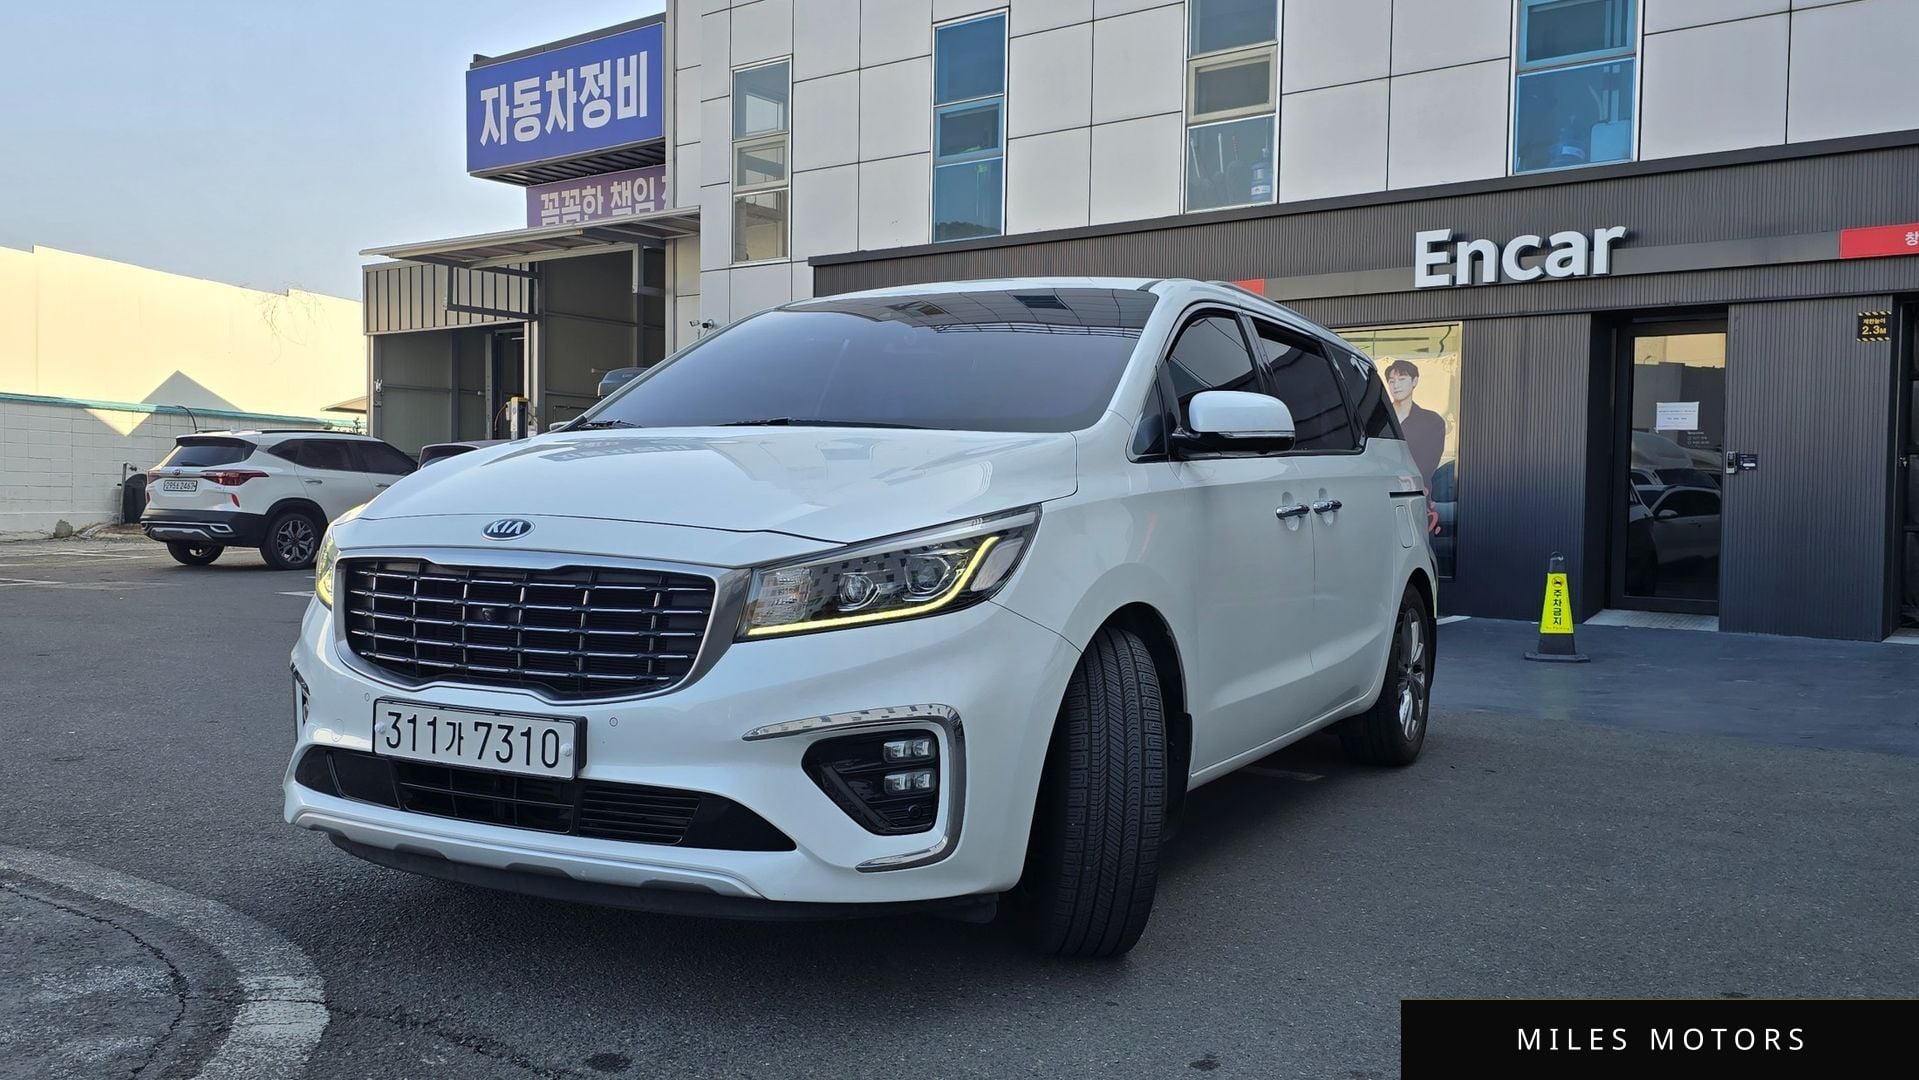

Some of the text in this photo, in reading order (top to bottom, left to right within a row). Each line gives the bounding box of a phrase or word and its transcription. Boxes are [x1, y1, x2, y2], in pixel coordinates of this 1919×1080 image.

[480, 51, 648, 146] 자동차정비
[610, 177, 655, 216] 책임
[1414, 225, 1627, 288] Encar
[487, 520, 524, 534] KIA
